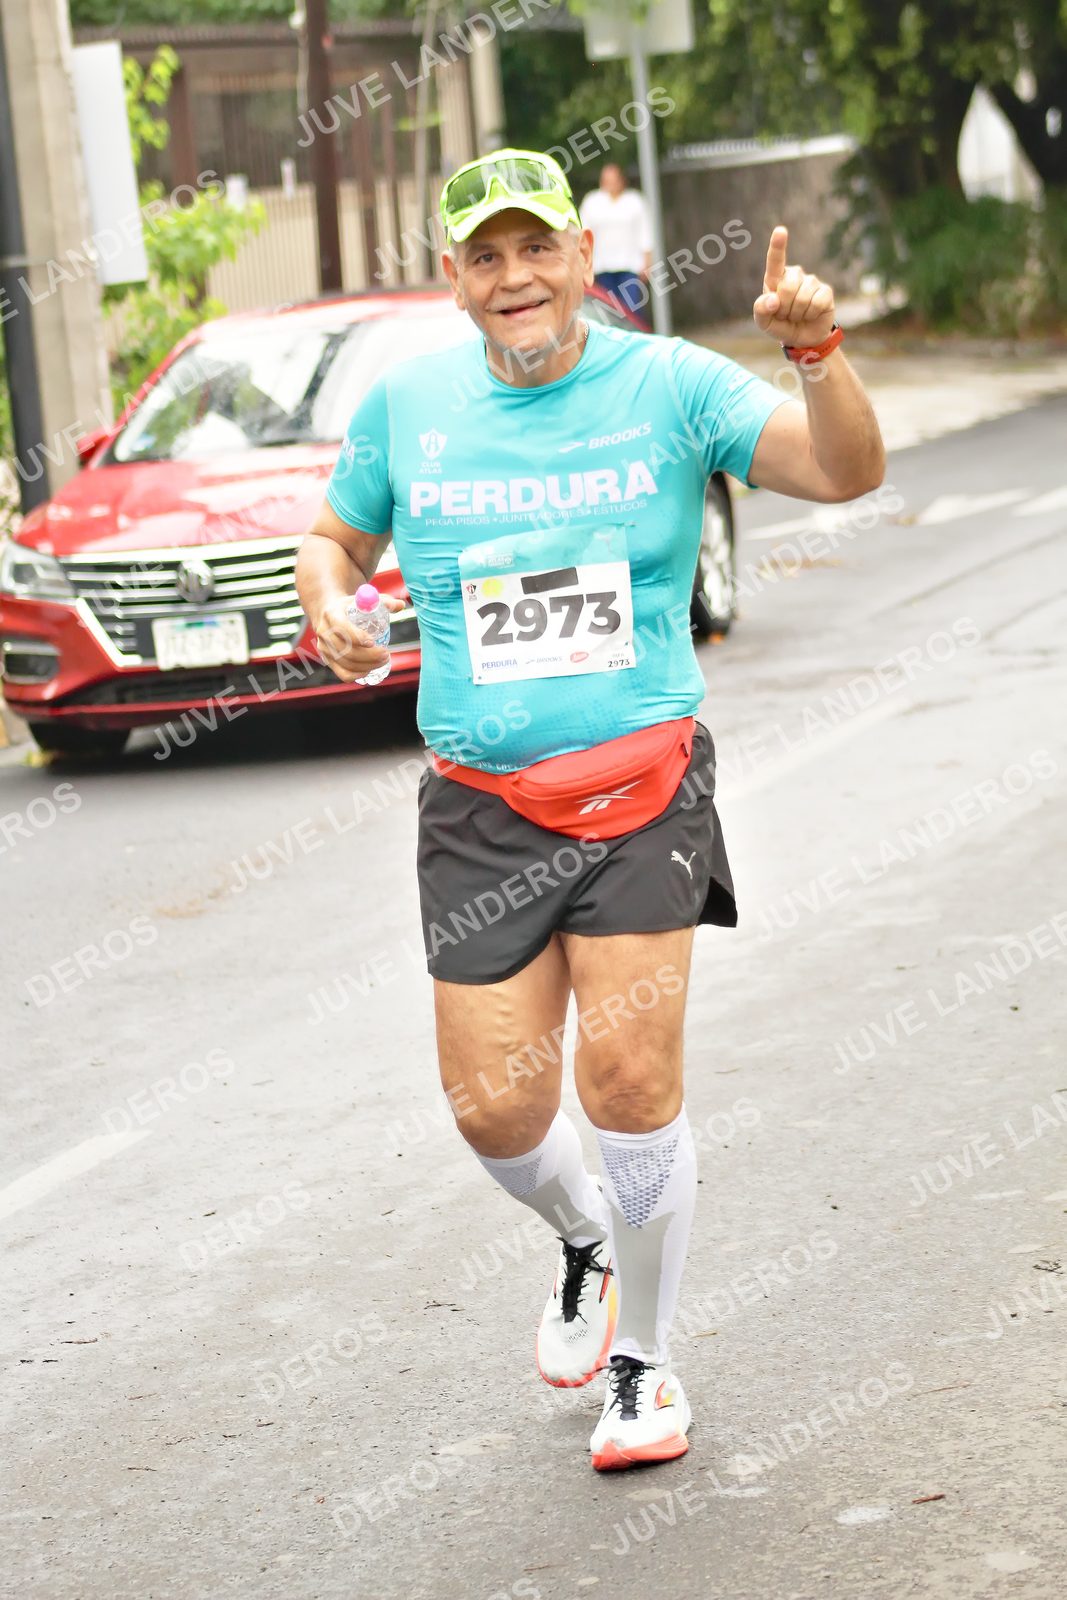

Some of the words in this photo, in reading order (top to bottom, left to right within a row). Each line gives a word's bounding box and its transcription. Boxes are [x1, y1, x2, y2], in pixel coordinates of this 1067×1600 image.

[588, 422, 651, 450] BROOKS
[409, 460, 658, 518] PERDURA
[456, 515, 490, 525] PISOS
[593, 500, 647, 515] ESTUCOS
[476, 591, 621, 646] 2973
[482, 658, 518, 669] PERDURA
[607, 659, 630, 668] 2973
